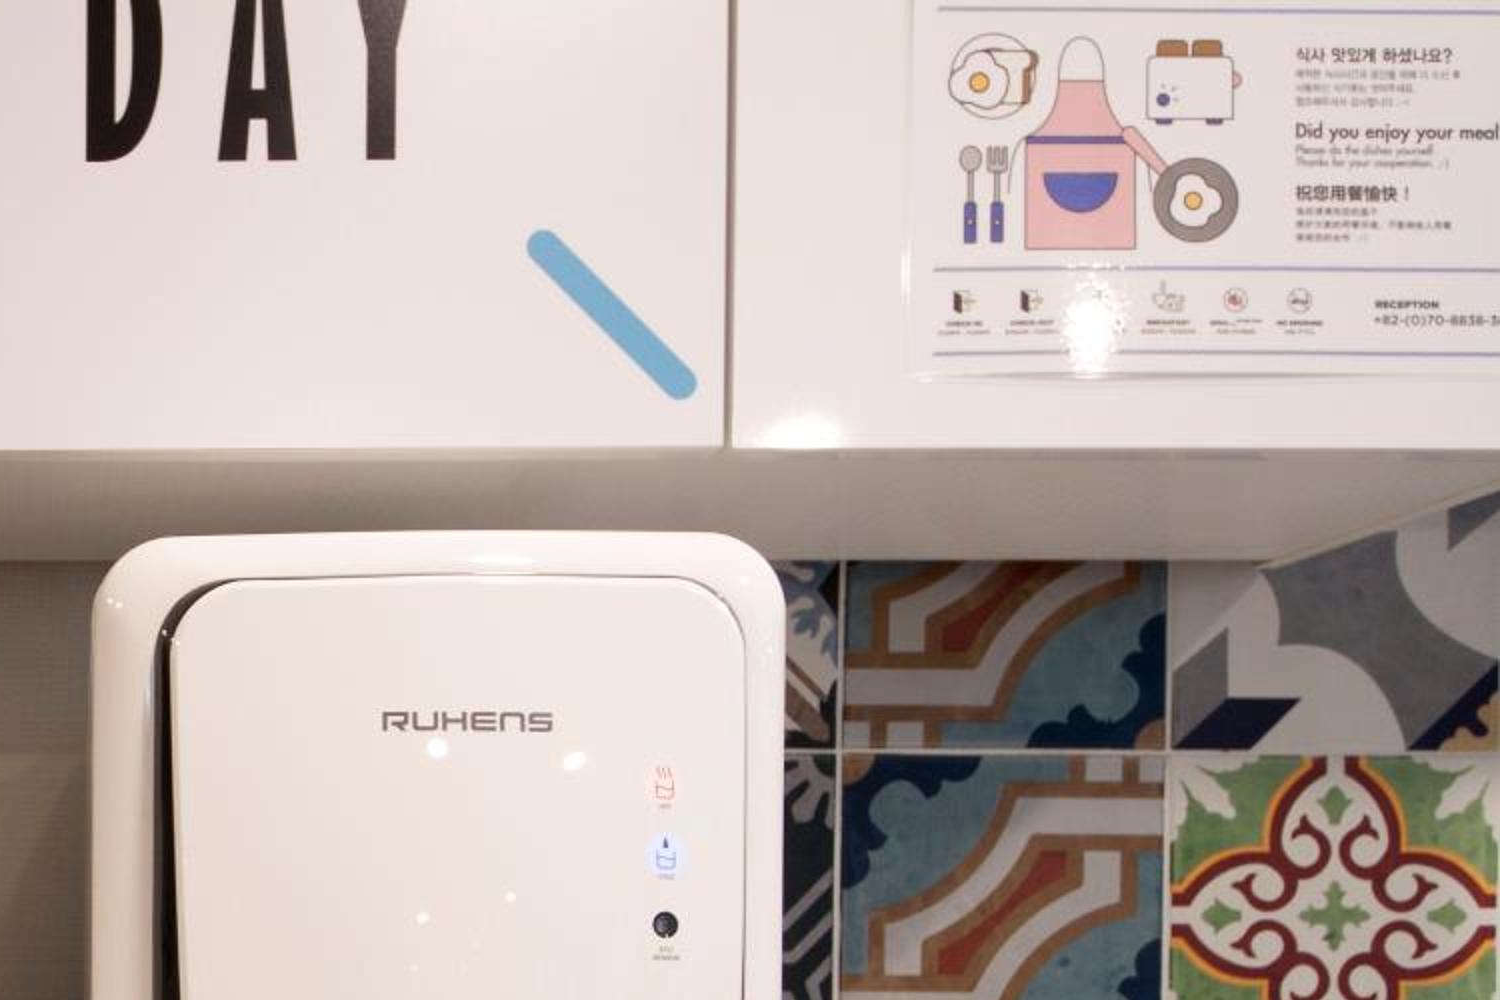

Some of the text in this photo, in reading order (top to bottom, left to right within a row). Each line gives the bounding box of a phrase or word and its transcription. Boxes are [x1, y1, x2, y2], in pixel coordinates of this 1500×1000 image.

[1296, 47, 1453, 64] 식사 맛있게 하셨나요?
[86, 0, 408, 162] DAY
[1296, 121, 1500, 144] Did you enjoy your meal
[1374, 300, 1439, 309] RECEPTION
[382, 711, 553, 732] RUHENS
